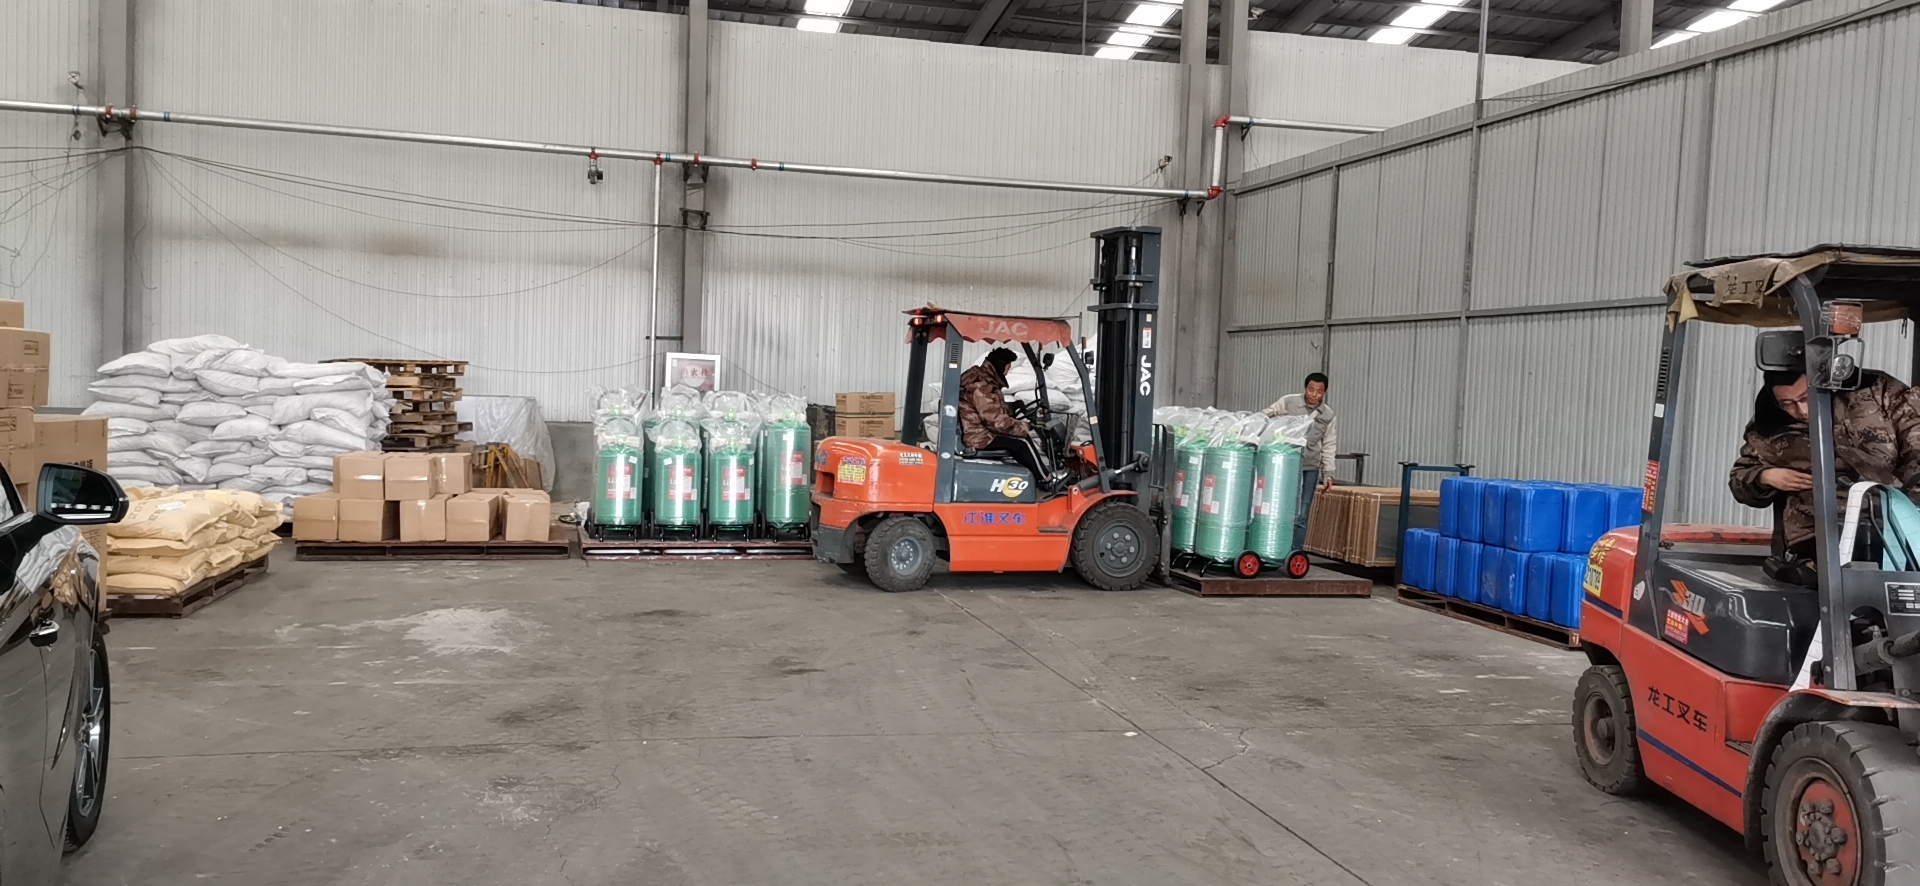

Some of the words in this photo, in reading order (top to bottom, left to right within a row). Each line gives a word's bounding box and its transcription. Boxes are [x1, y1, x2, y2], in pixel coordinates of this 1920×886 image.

[980, 321, 1028, 336] JAC
[1139, 354, 1152, 396] JAC
[963, 510, 1025, 525] 江淮叉车
[1682, 590, 1706, 617] 30
[1648, 686, 1708, 733] 龙工叉车
